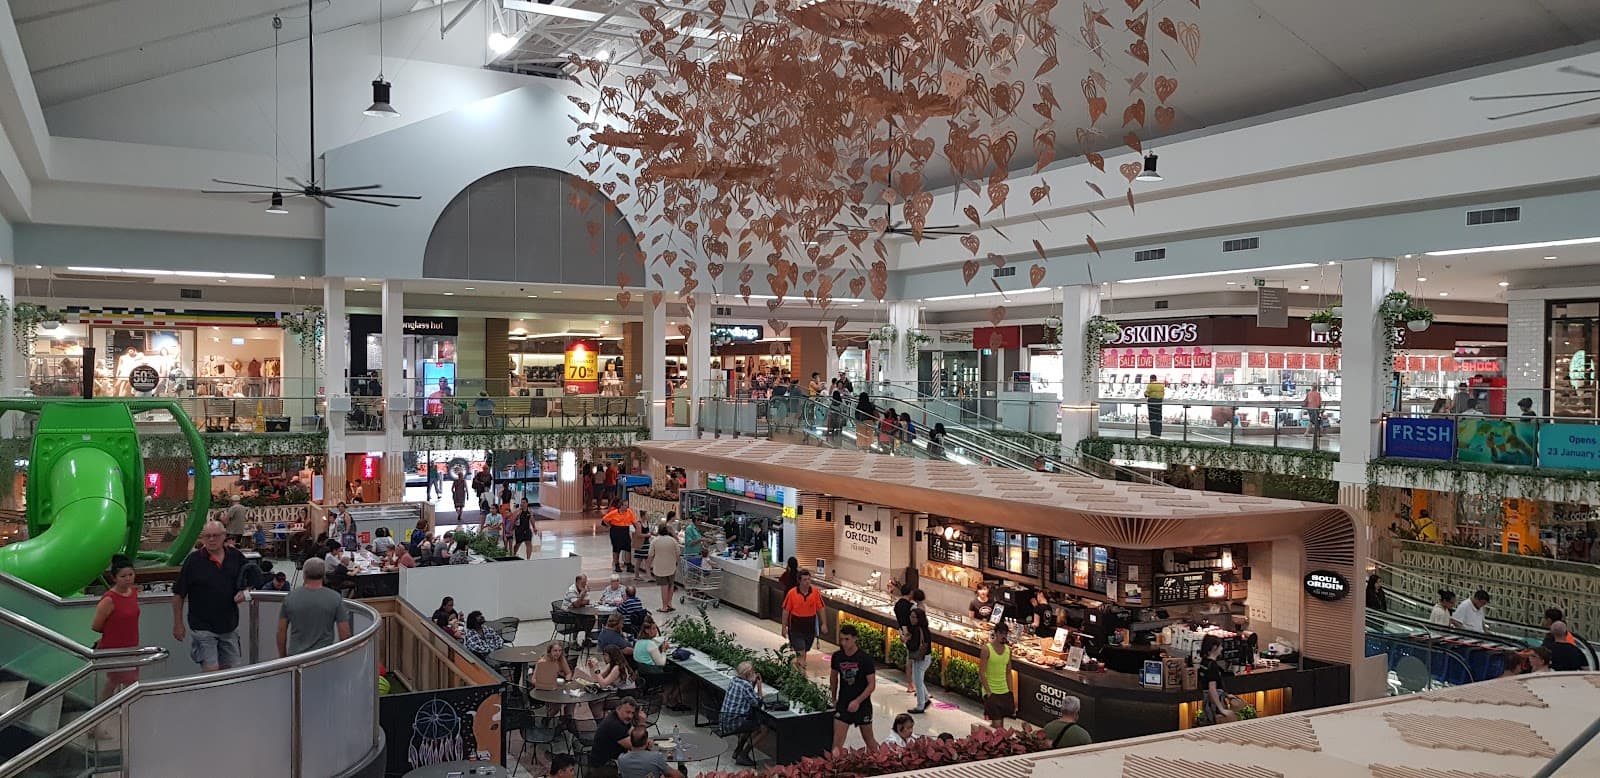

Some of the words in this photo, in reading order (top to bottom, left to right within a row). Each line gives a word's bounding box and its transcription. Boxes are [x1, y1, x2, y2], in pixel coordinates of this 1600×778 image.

[1120, 355, 1135, 367] SALE
[1174, 355, 1191, 367] SALE
[1194, 355, 1210, 367] LOVE
[1218, 353, 1241, 367] SAVE
[1392, 424, 1451, 443] FRESH
[1568, 435, 1597, 446] Opens
[1547, 447, 1558, 456] 23
[1560, 447, 1594, 460] January
[849, 520, 874, 534] SOUL
[845, 530, 878, 545] ORIGIN
[1311, 574, 1340, 584] SOUL
[1306, 580, 1344, 591] ORIGIN
